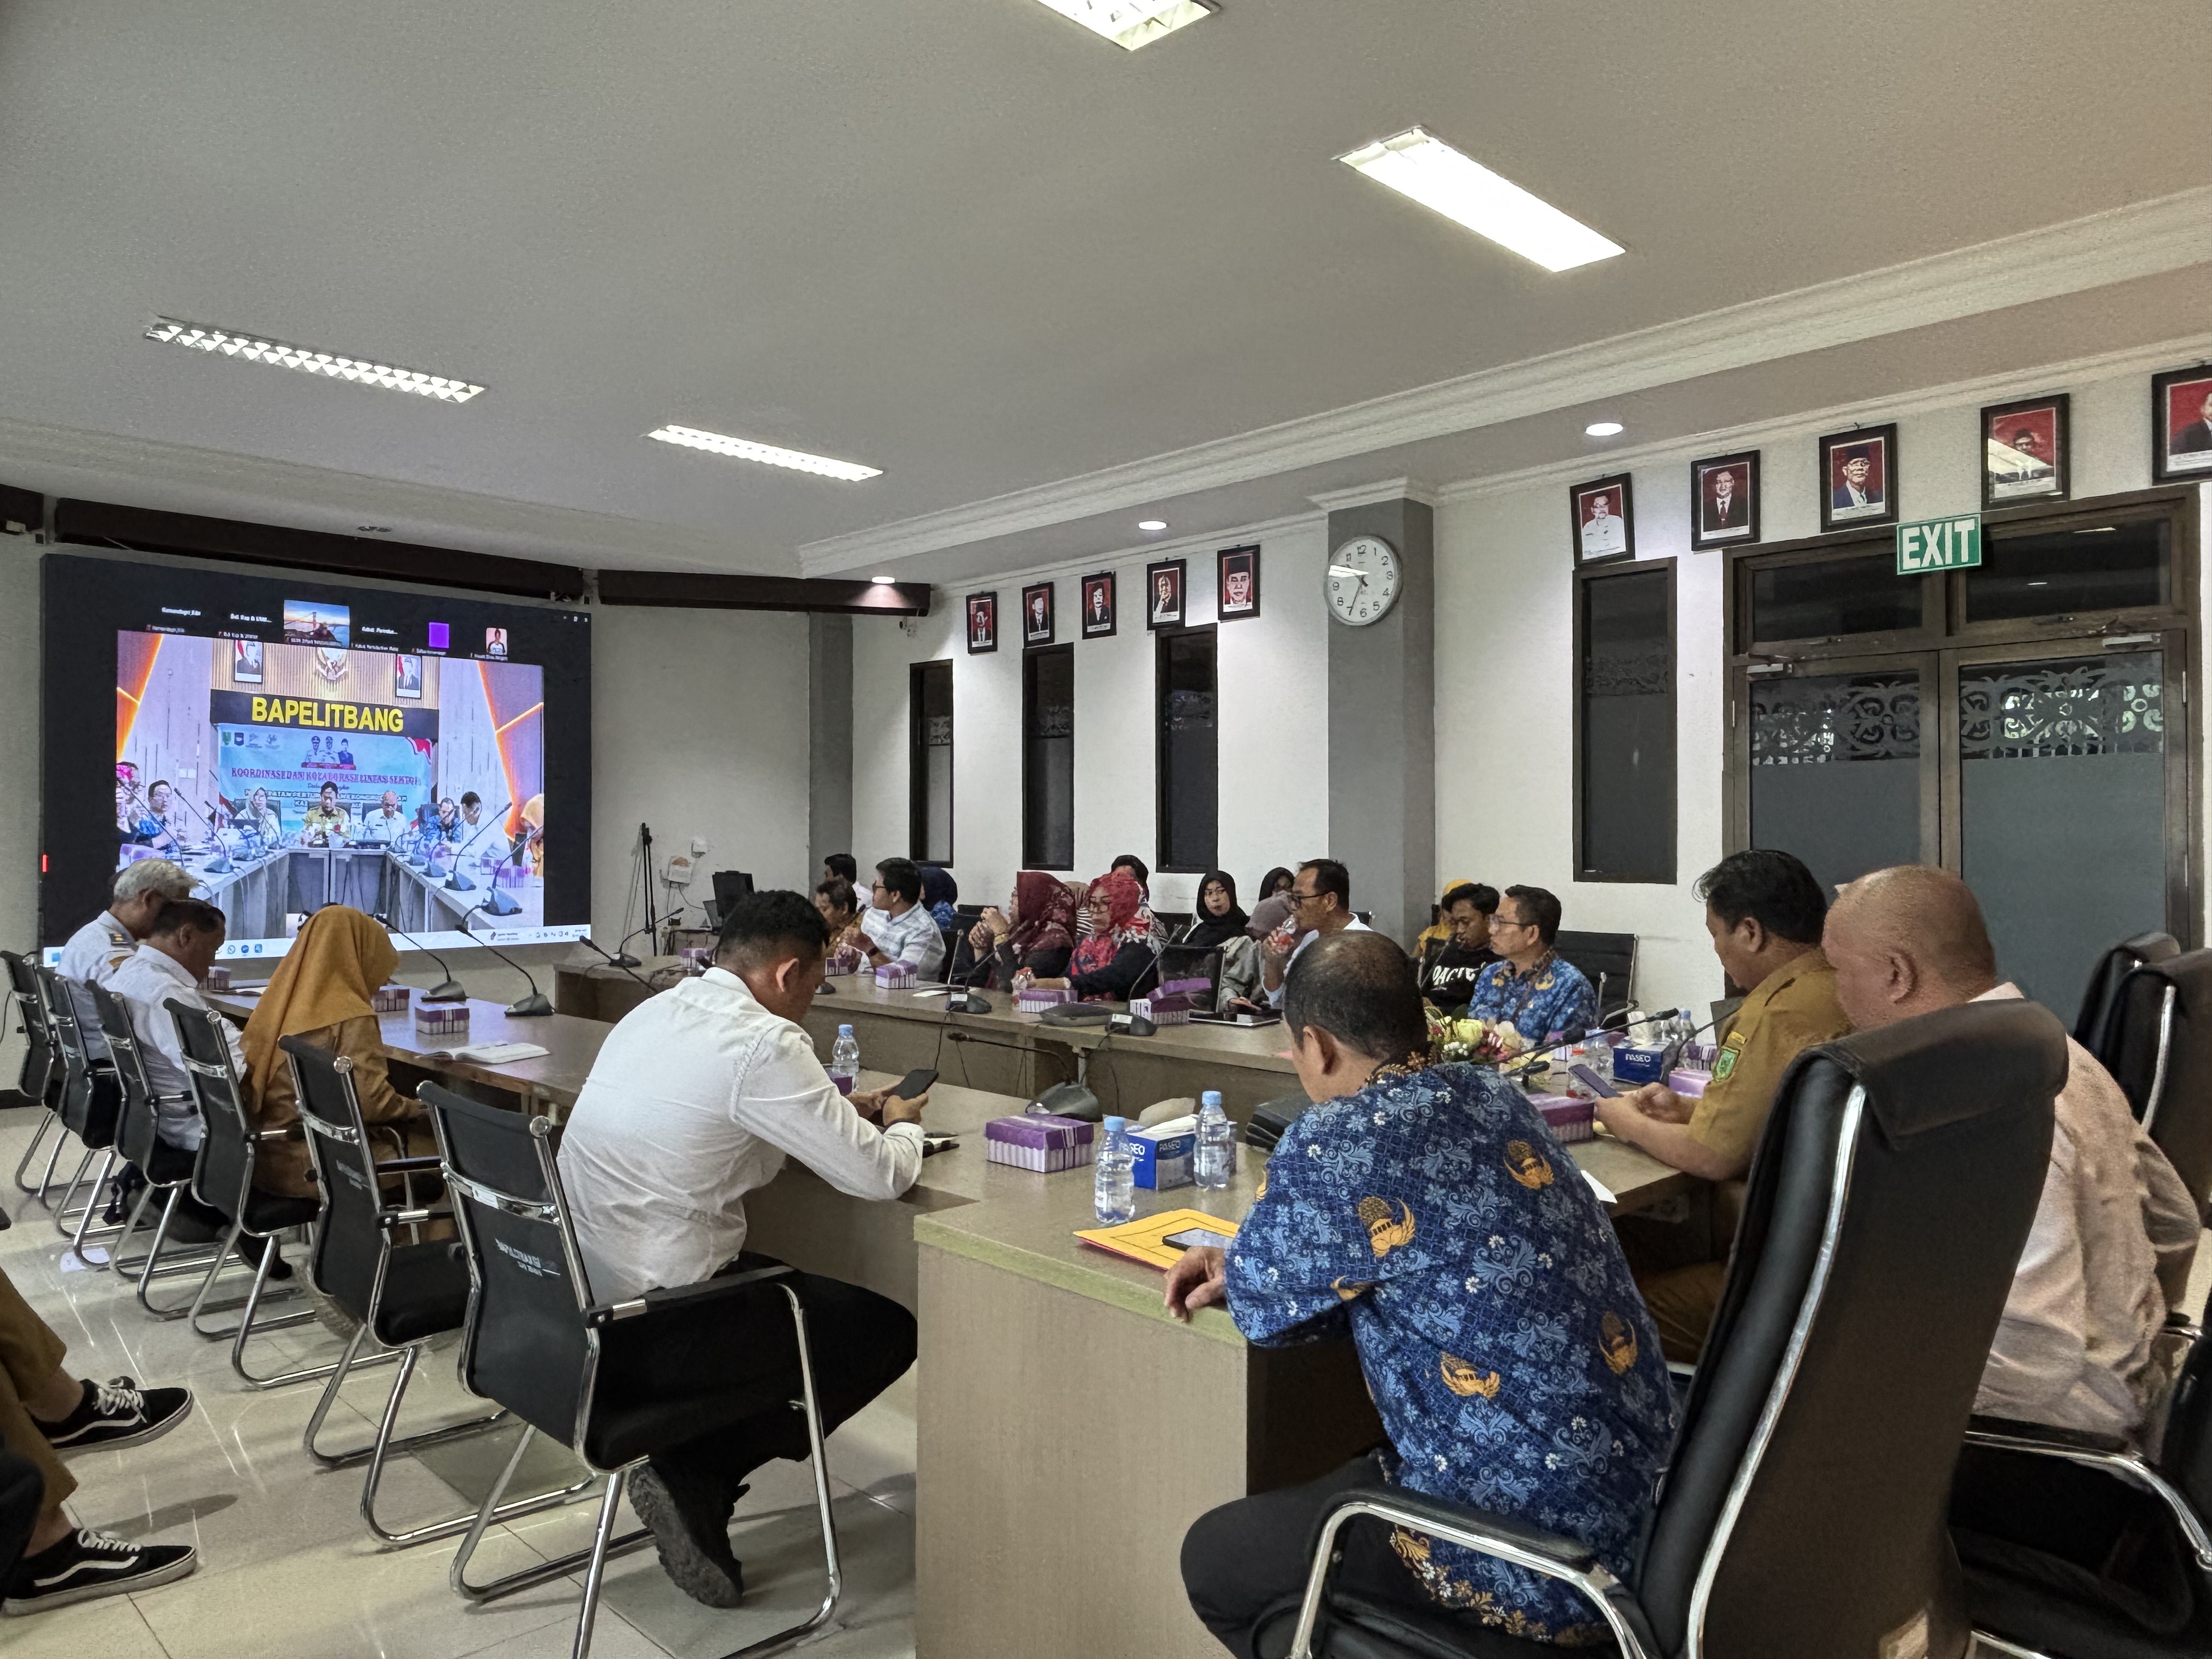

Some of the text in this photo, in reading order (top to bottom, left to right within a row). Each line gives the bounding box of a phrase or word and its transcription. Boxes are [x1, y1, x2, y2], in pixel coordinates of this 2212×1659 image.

[1902, 518, 1976, 570] EXIT
[1373, 547, 1377, 556] 1
[1381, 555, 1389, 566] 2
[1386, 571, 1393, 580] 3
[1332, 582, 1340, 591] 9
[1382, 588, 1390, 597] 4
[1337, 596, 1344, 606] 8
[1373, 601, 1380, 611] 5
[1346, 606, 1353, 616] 7
[1359, 608, 1367, 618] 6
[251, 696, 404, 732] BAPELITBANG
[1625, 1053, 1651, 1063] PASEO
[1159, 1139, 1181, 1152] PASEO
